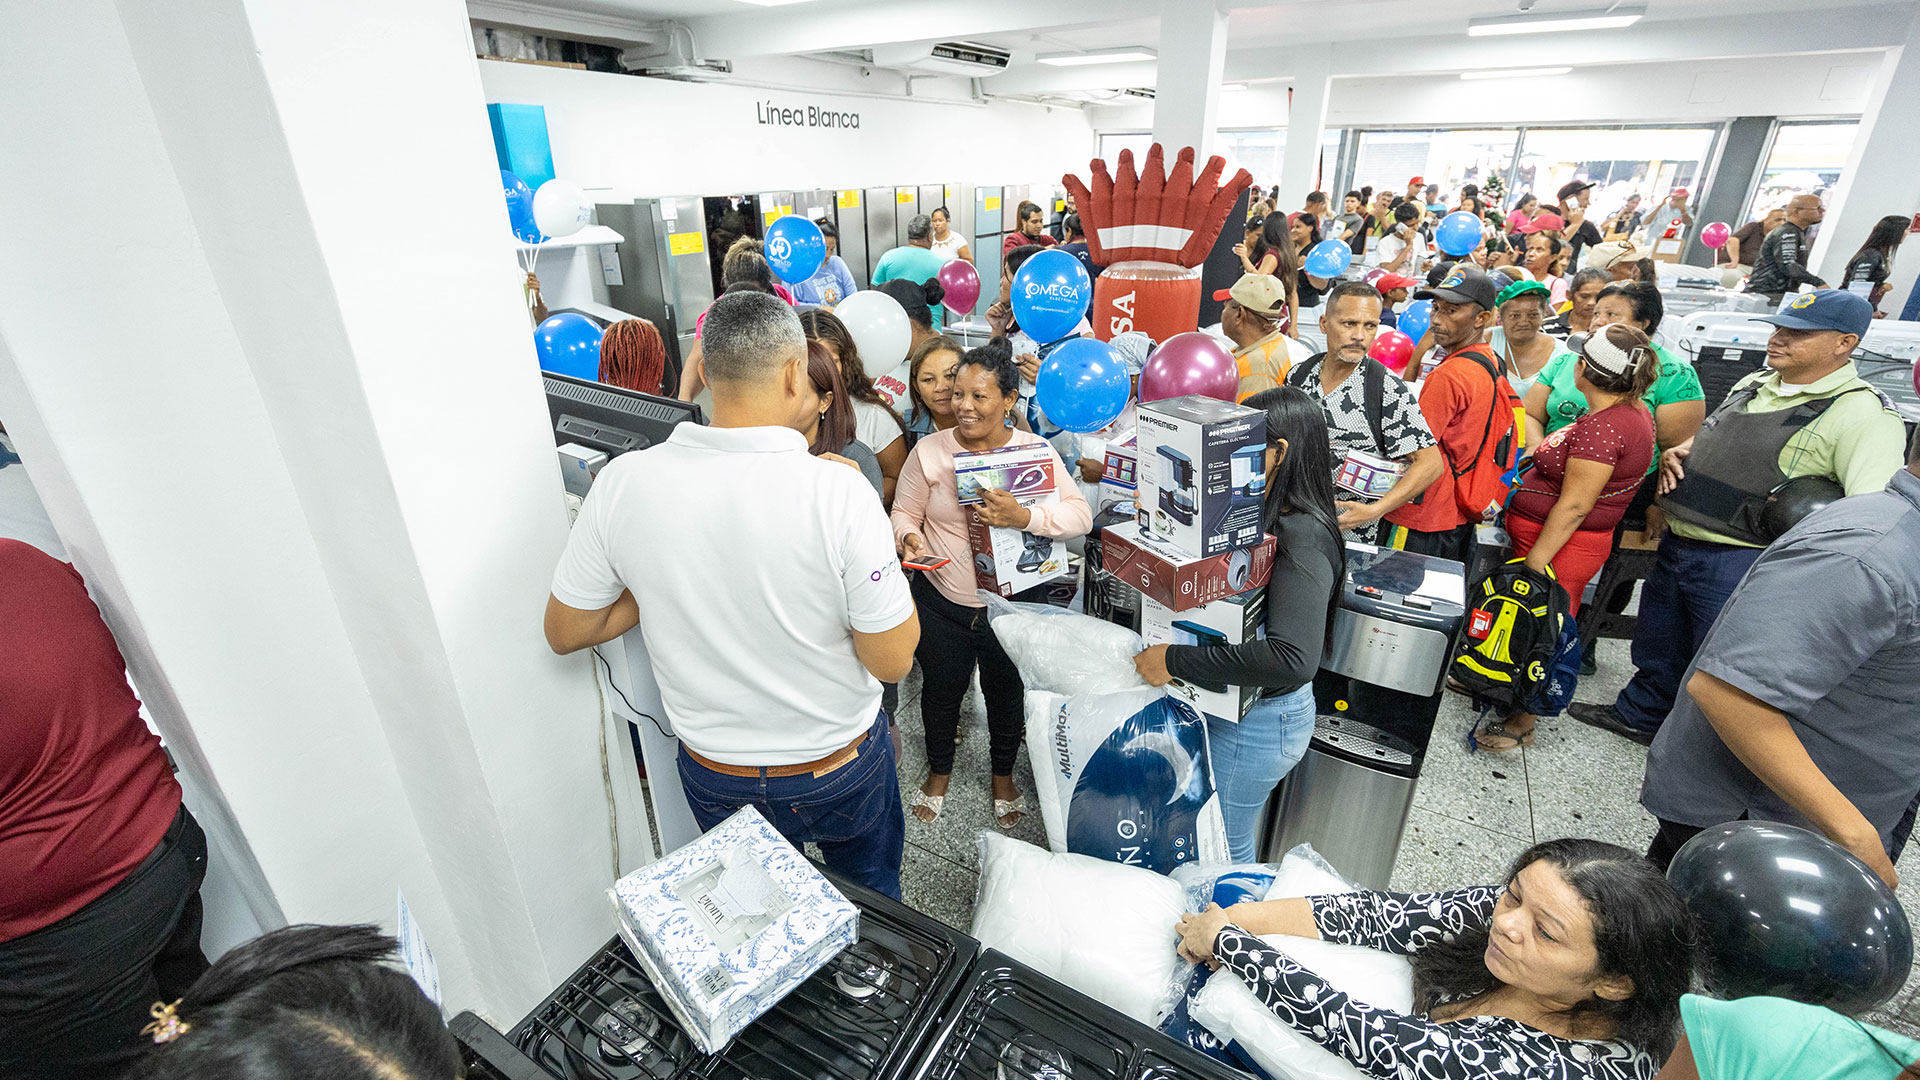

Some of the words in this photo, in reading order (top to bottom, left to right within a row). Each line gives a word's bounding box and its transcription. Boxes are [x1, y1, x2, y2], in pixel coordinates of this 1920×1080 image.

[757, 100, 804, 126] Línea
[808, 105, 860, 129] Blanca
[1025, 282, 1079, 299] OMEGA
[1149, 417, 1178, 432] PREMIER
[1220, 424, 1251, 436] PREMIER
[1229, 435, 1250, 443] ELÉCTRICA
[1055, 706, 1073, 776] MultiMax
[703, 974, 720, 995] Twin
